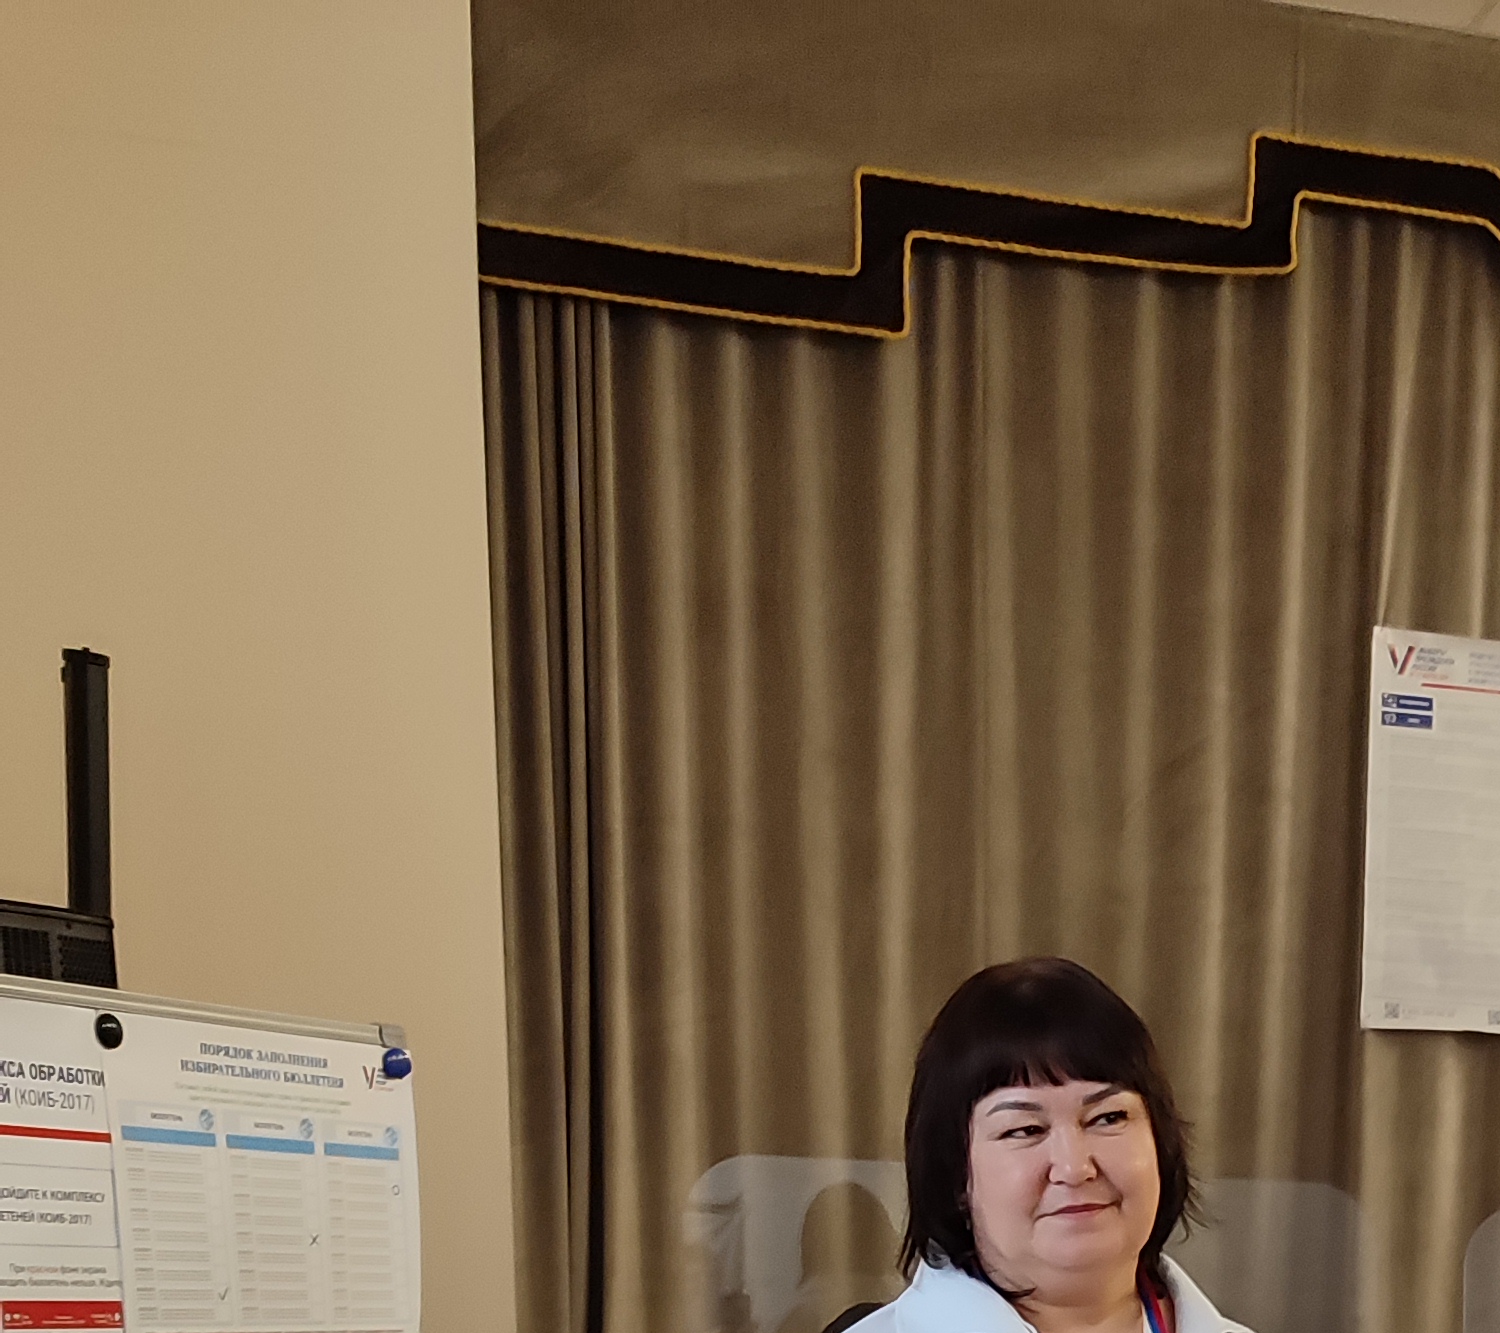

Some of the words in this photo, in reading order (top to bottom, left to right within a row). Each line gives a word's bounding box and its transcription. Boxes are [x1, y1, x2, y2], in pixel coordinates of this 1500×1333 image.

[200, 1043, 253, 1060] ПОРЯДОК
[29, 1063, 105, 1087] ОБРАБОТКИ
[15, 1087, 95, 1115] (КОИБ-2017)
